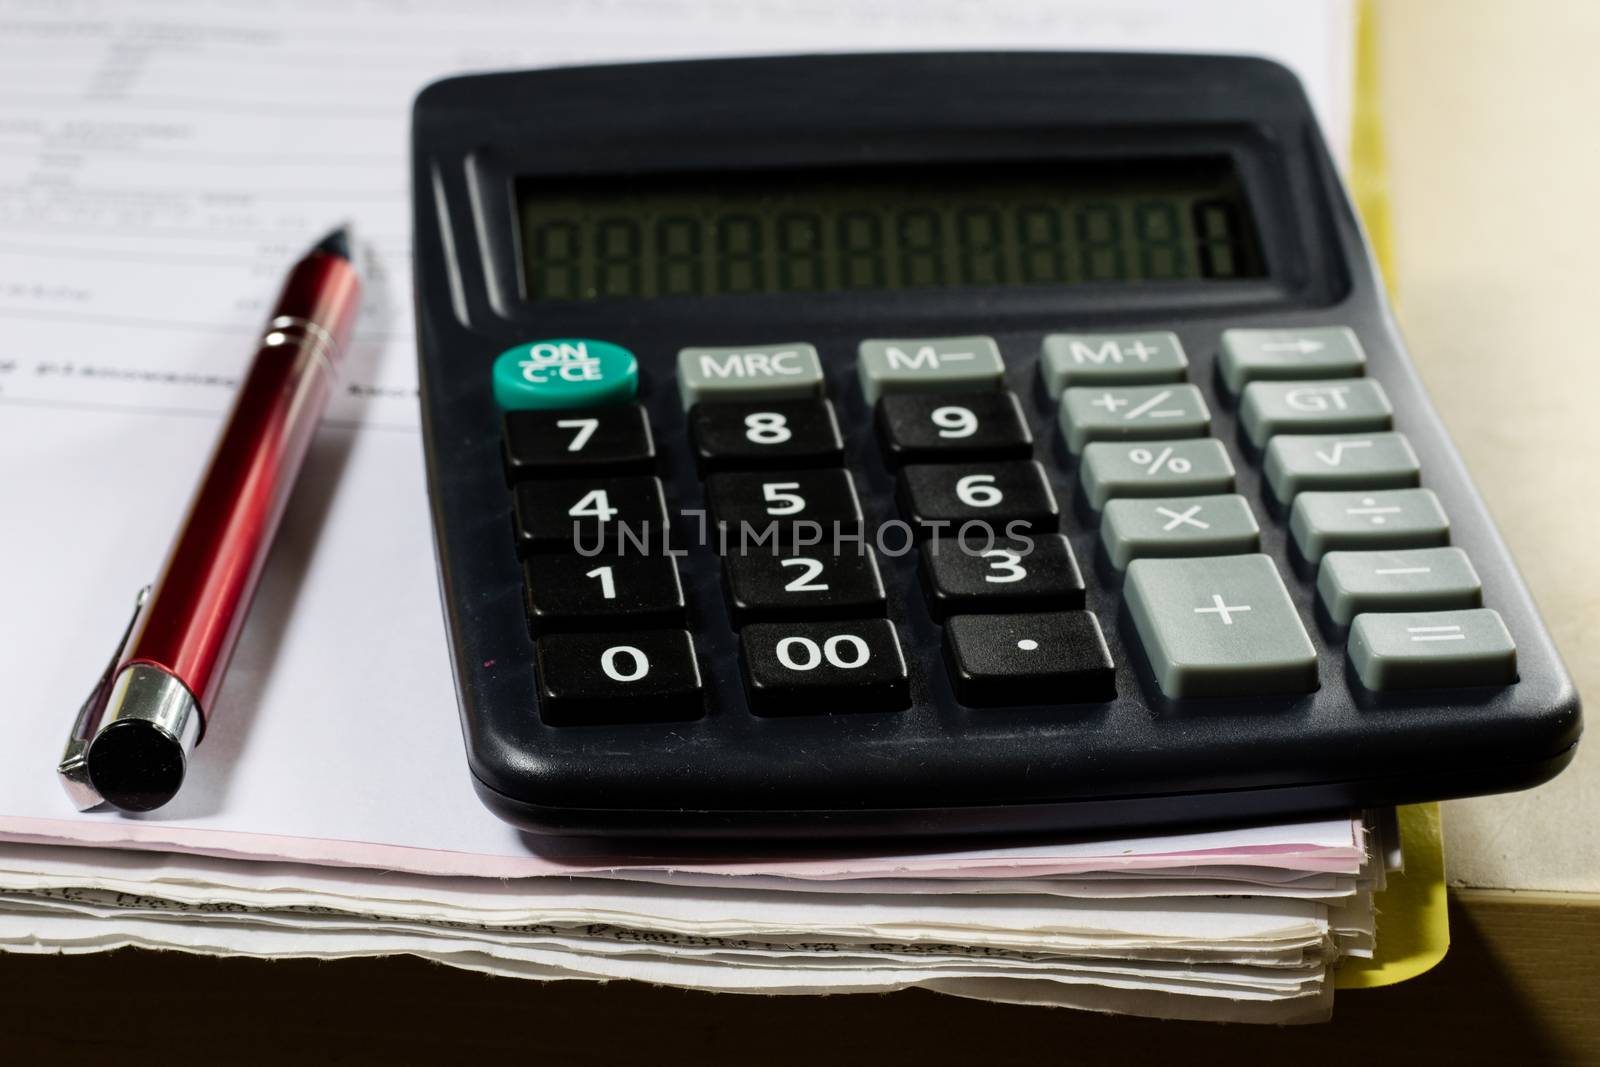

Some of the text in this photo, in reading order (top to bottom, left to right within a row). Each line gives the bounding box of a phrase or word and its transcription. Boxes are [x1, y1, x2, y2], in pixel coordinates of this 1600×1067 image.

[529, 342, 589, 363] ON
[699, 350, 805, 379] MRC
[1069, 339, 1160, 365] M+
[1285, 386, 1350, 412] GT
[558, 420, 598, 450] 7
[745, 413, 790, 443] 8
[932, 407, 977, 437] 9
[1129, 447, 1192, 475] %
[764, 483, 805, 514] 5
[957, 475, 1002, 506] 6
[569, 491, 617, 521] 4
[782, 559, 828, 591] 2
[980, 550, 1026, 582] 3
[587, 567, 615, 598] 1
[601, 646, 649, 681] 0
[776, 635, 870, 670] 00
